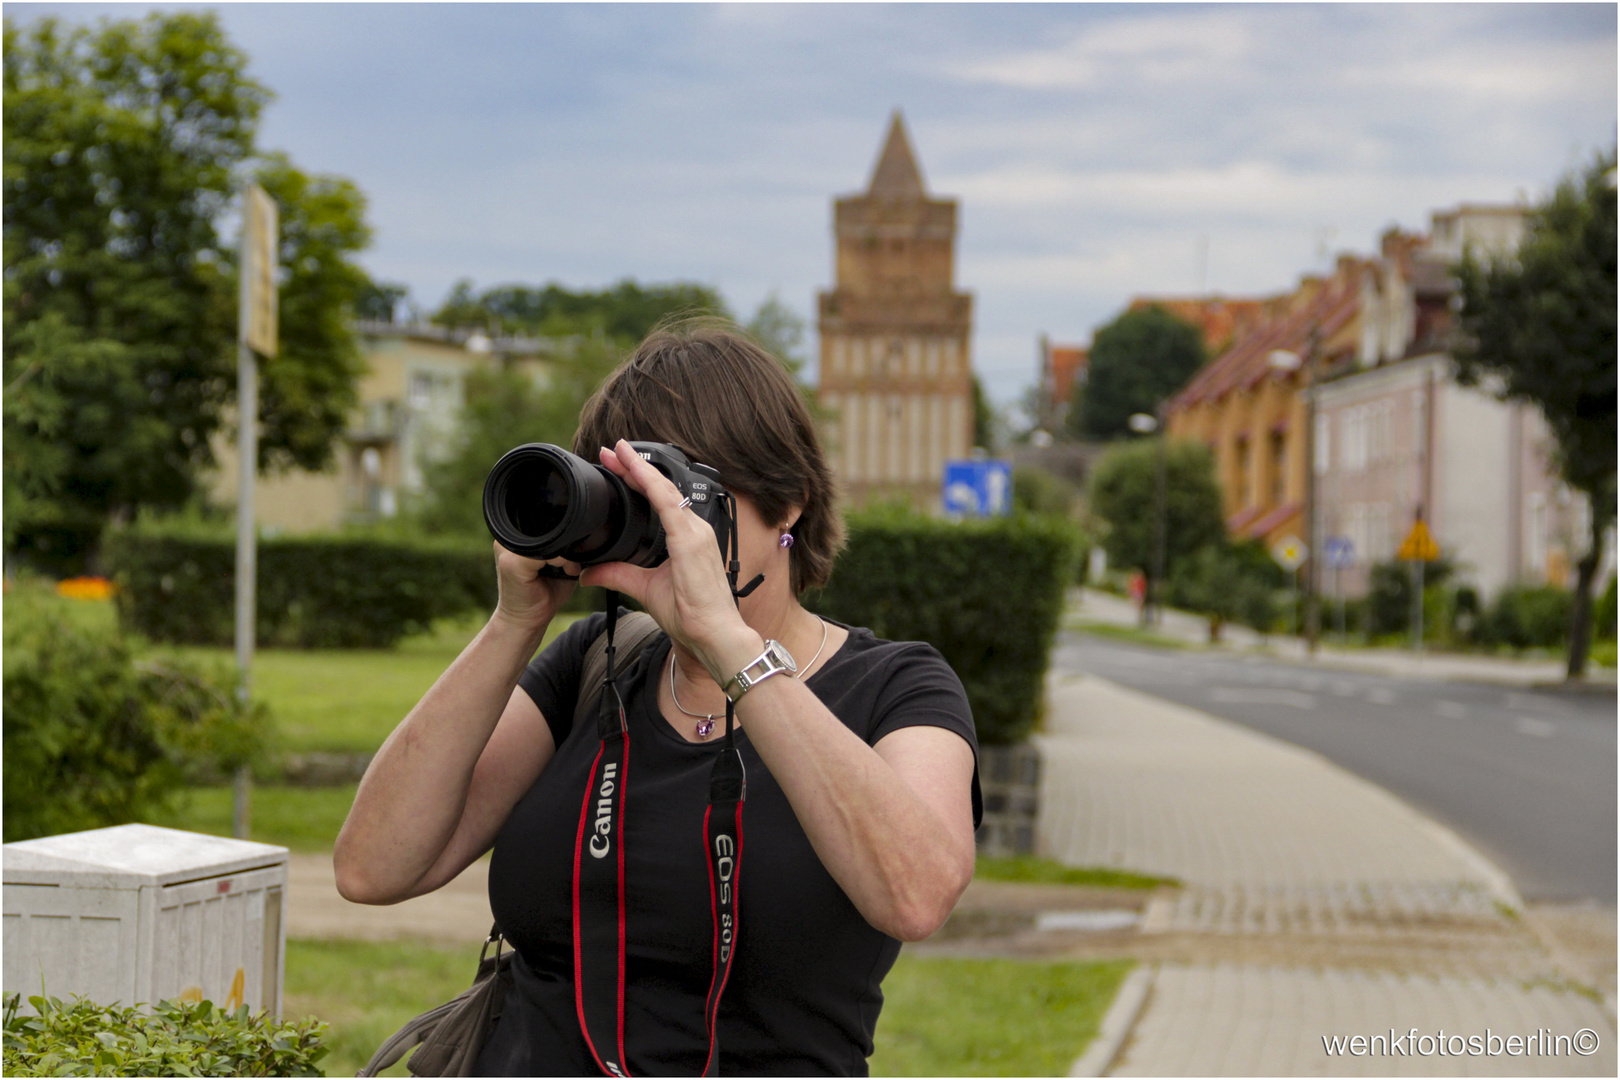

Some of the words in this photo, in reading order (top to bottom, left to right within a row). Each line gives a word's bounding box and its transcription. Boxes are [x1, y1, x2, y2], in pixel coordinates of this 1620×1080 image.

[691, 492, 706, 501] 80D
[692, 482, 707, 490] EOS
[589, 762, 617, 859] Canon
[715, 834, 734, 905] EOS
[720, 913, 732, 963] 80D
